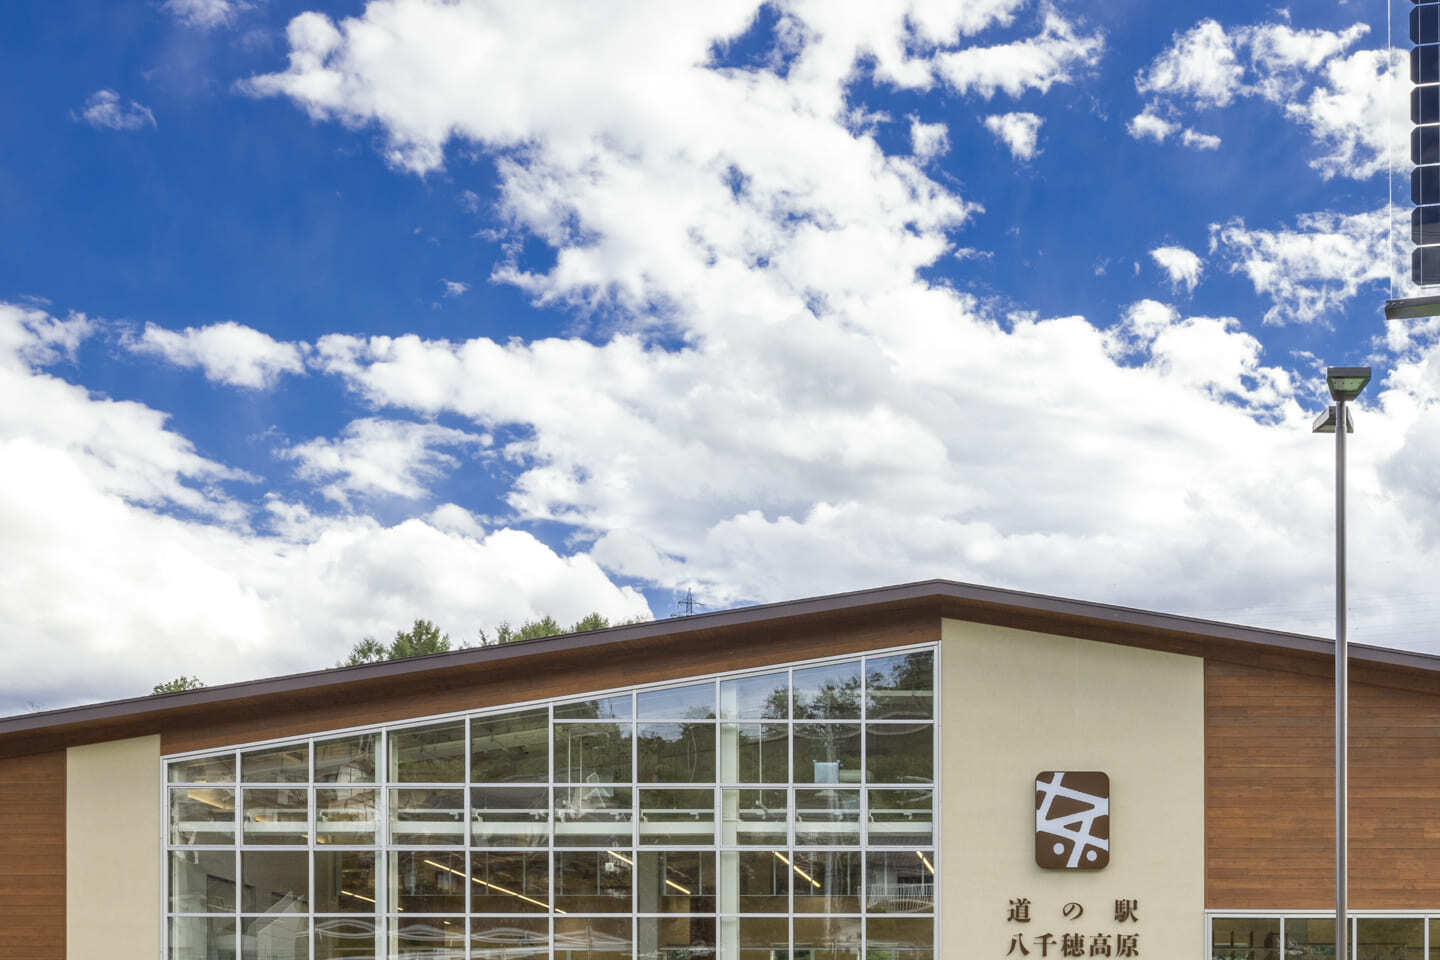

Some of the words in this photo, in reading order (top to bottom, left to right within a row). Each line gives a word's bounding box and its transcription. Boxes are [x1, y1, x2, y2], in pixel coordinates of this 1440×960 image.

[1006, 933, 1139, 957] 八千穂高原
